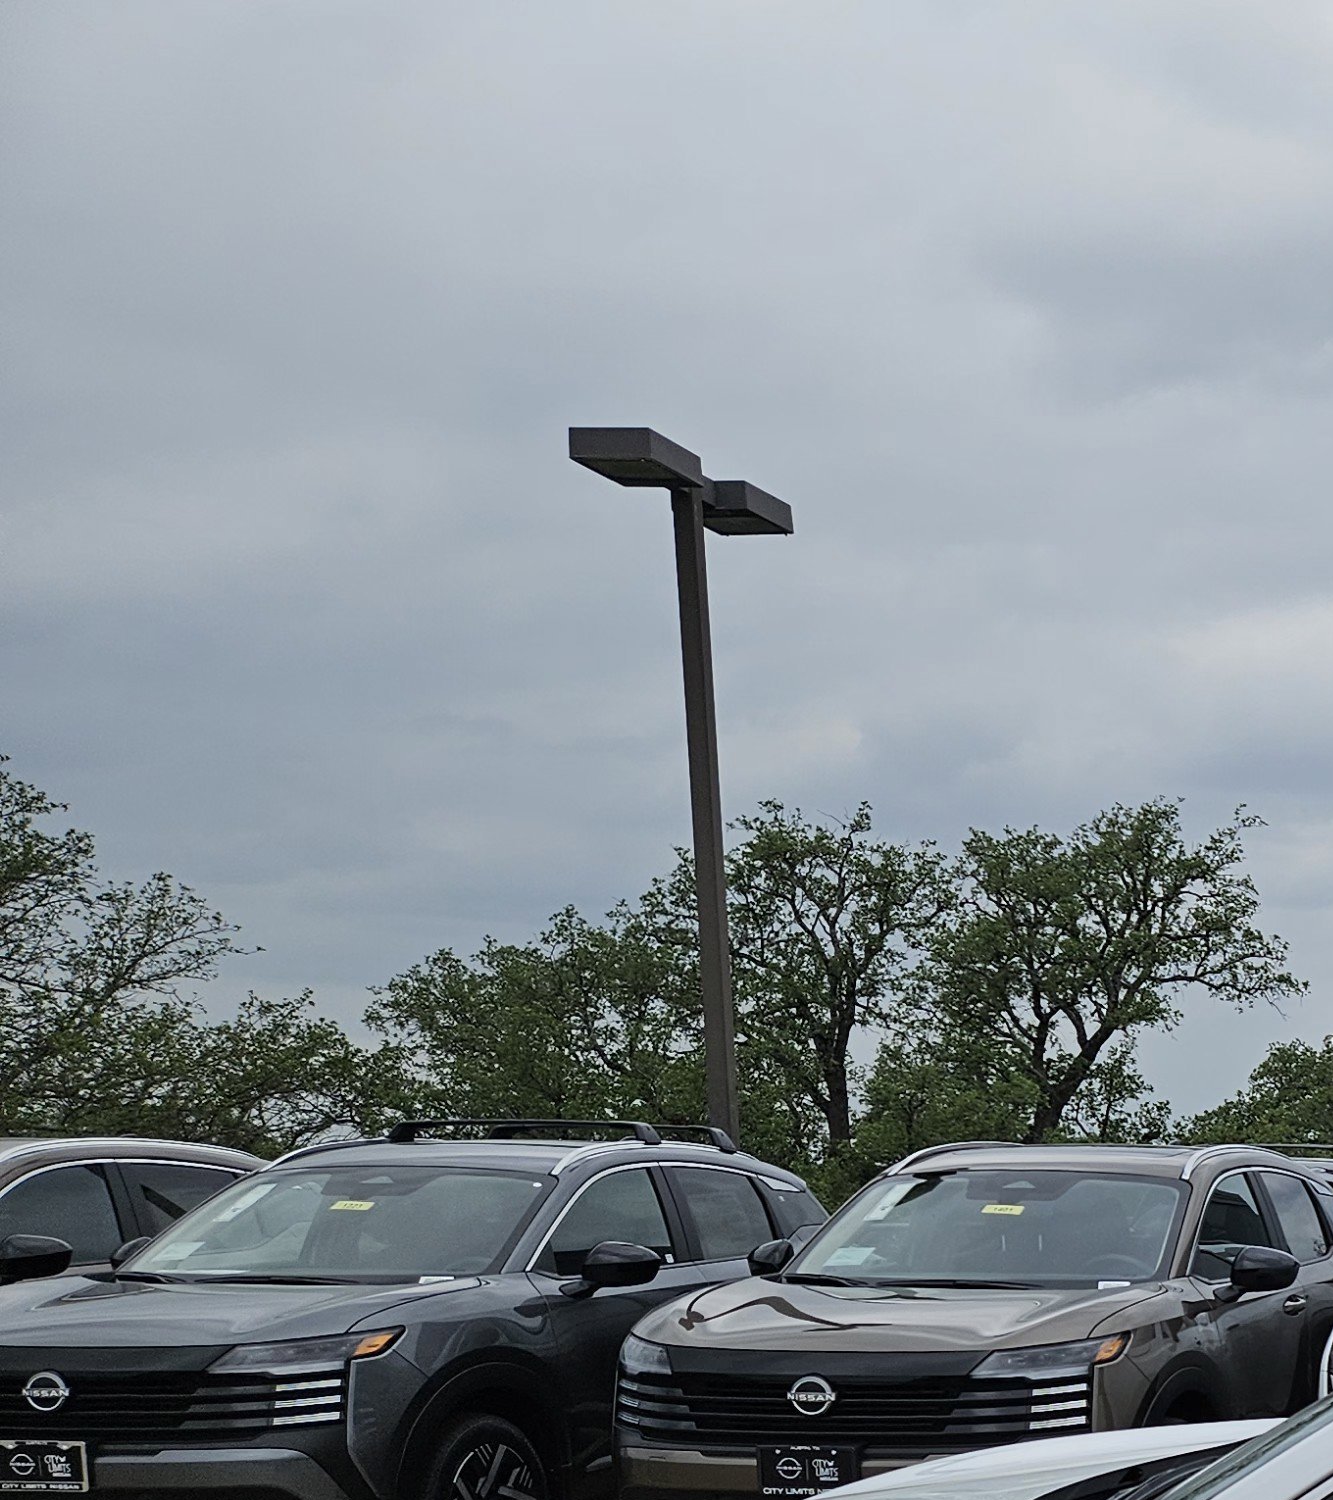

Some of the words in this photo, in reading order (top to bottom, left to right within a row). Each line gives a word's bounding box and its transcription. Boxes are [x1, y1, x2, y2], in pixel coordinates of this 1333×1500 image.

[22, 1387, 70, 1398] NISSAN
[786, 1391, 836, 1402] NISSAN
[762, 1486, 784, 1495] CITY
[785, 1487, 815, 1495] LIMITS
